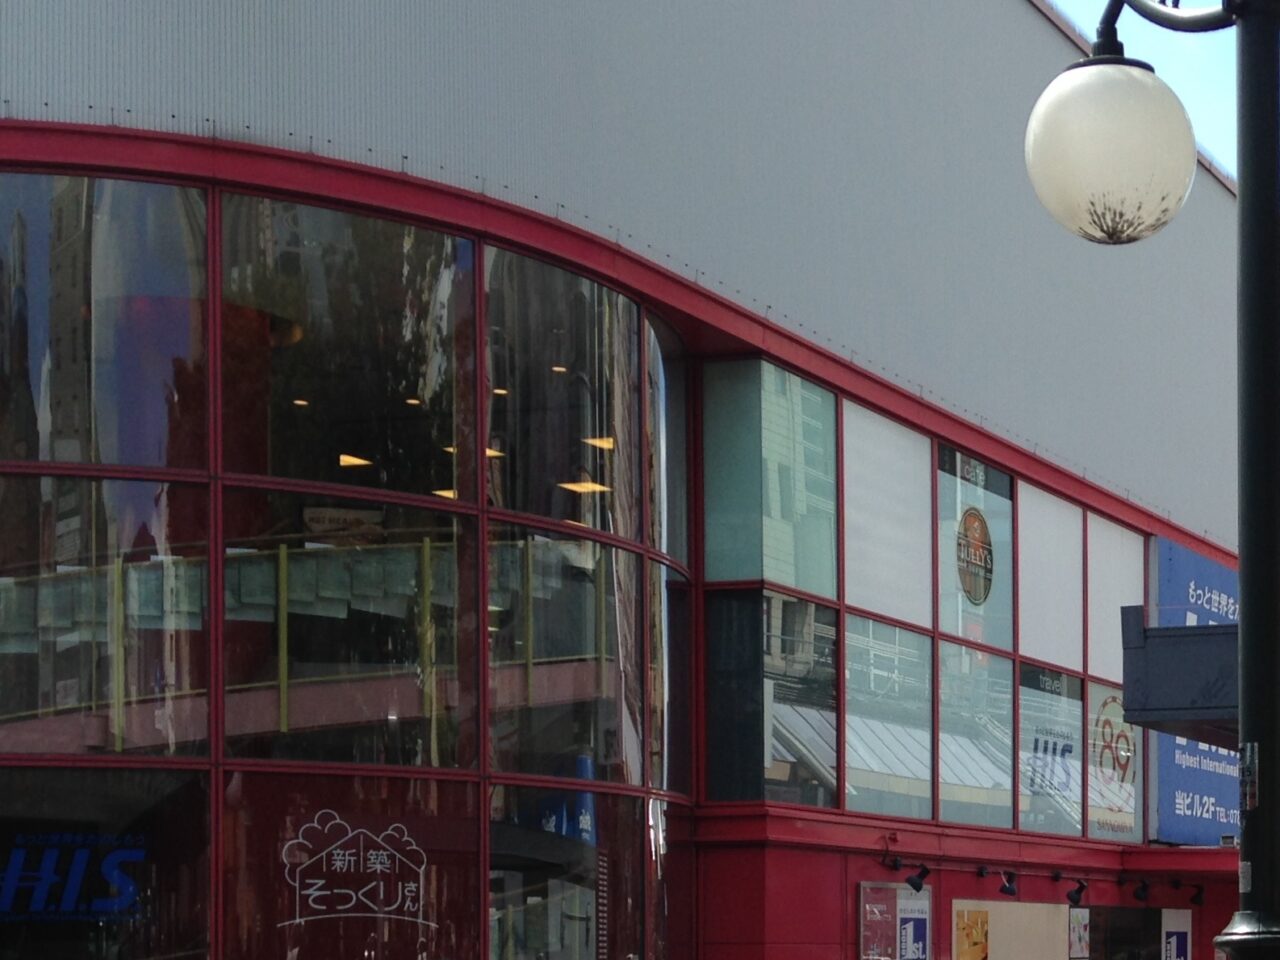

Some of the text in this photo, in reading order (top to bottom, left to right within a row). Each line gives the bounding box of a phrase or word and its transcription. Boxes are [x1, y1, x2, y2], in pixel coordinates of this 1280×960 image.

[1175, 750, 1200, 769] Highest
[1175, 789, 1216, 819] 当ビル2F
[331, 848, 392, 873] 新築
